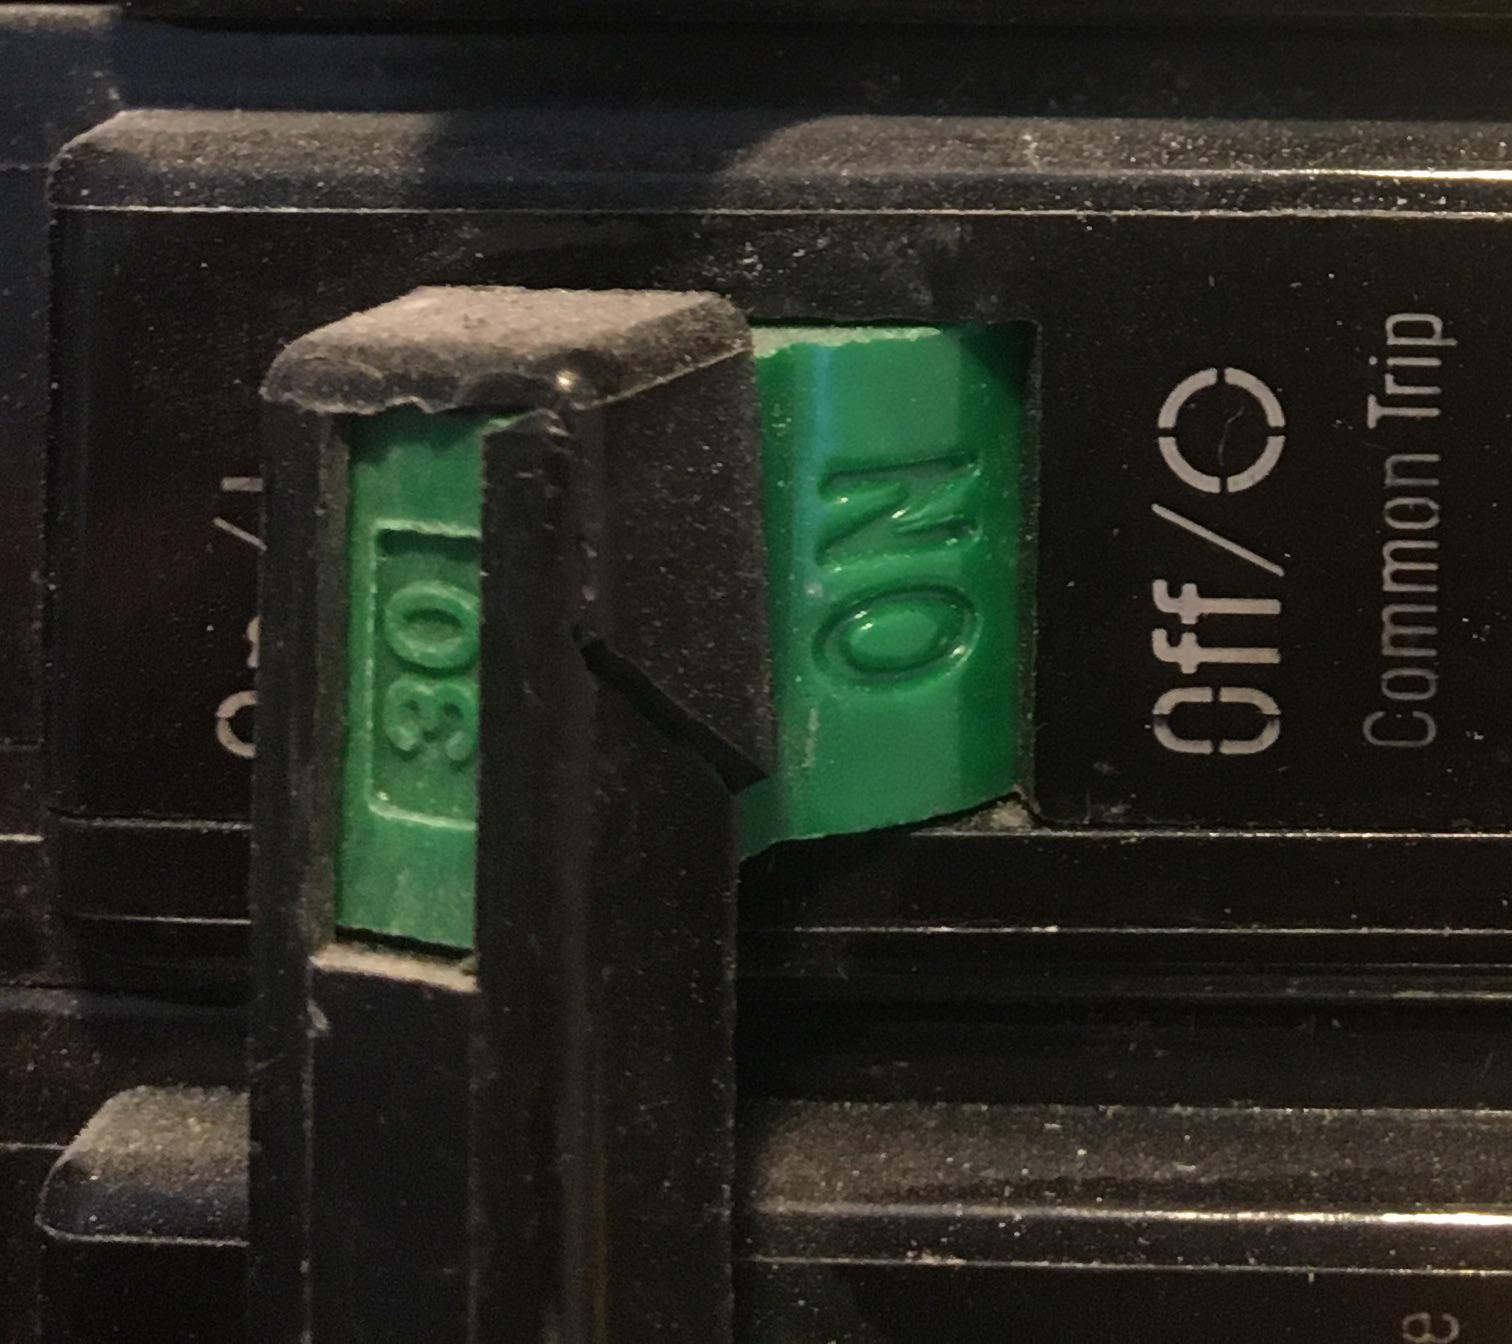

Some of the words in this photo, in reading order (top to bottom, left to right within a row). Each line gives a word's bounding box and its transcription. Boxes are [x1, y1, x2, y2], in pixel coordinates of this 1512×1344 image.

[1367, 311, 1457, 430] Trip
[381, 580, 482, 765] 30
[812, 448, 983, 690] ON
[1363, 448, 1441, 750] Common
